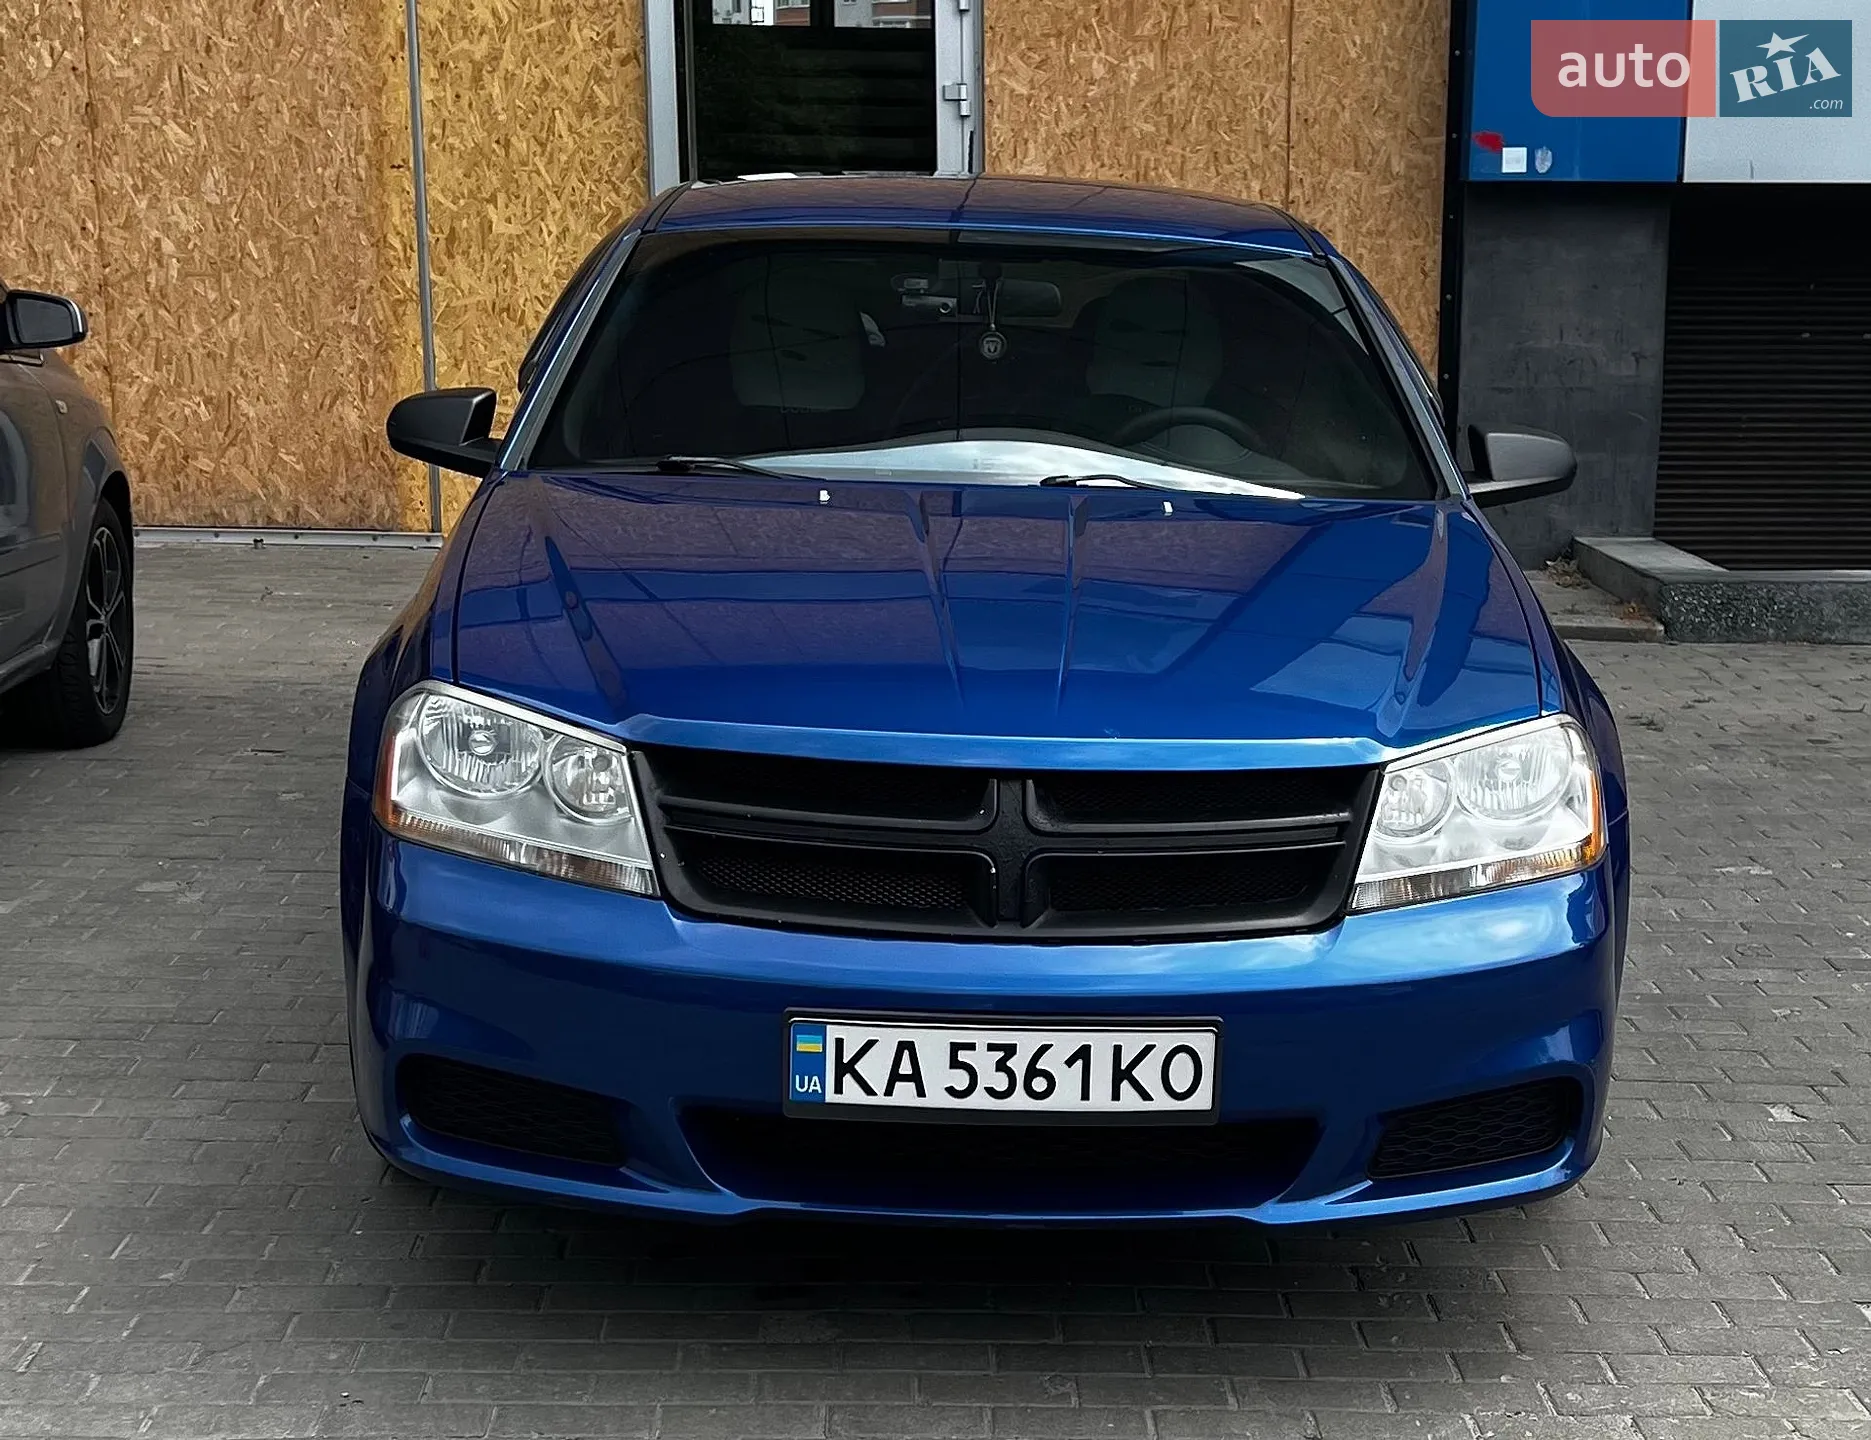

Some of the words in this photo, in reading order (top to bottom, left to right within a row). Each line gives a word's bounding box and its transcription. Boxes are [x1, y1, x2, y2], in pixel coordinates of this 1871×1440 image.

[794, 1074, 822, 1094] UA
[833, 1037, 927, 1099] KA
[943, 1041, 1094, 1101] 5361
[1111, 1043, 1204, 1102] KO
